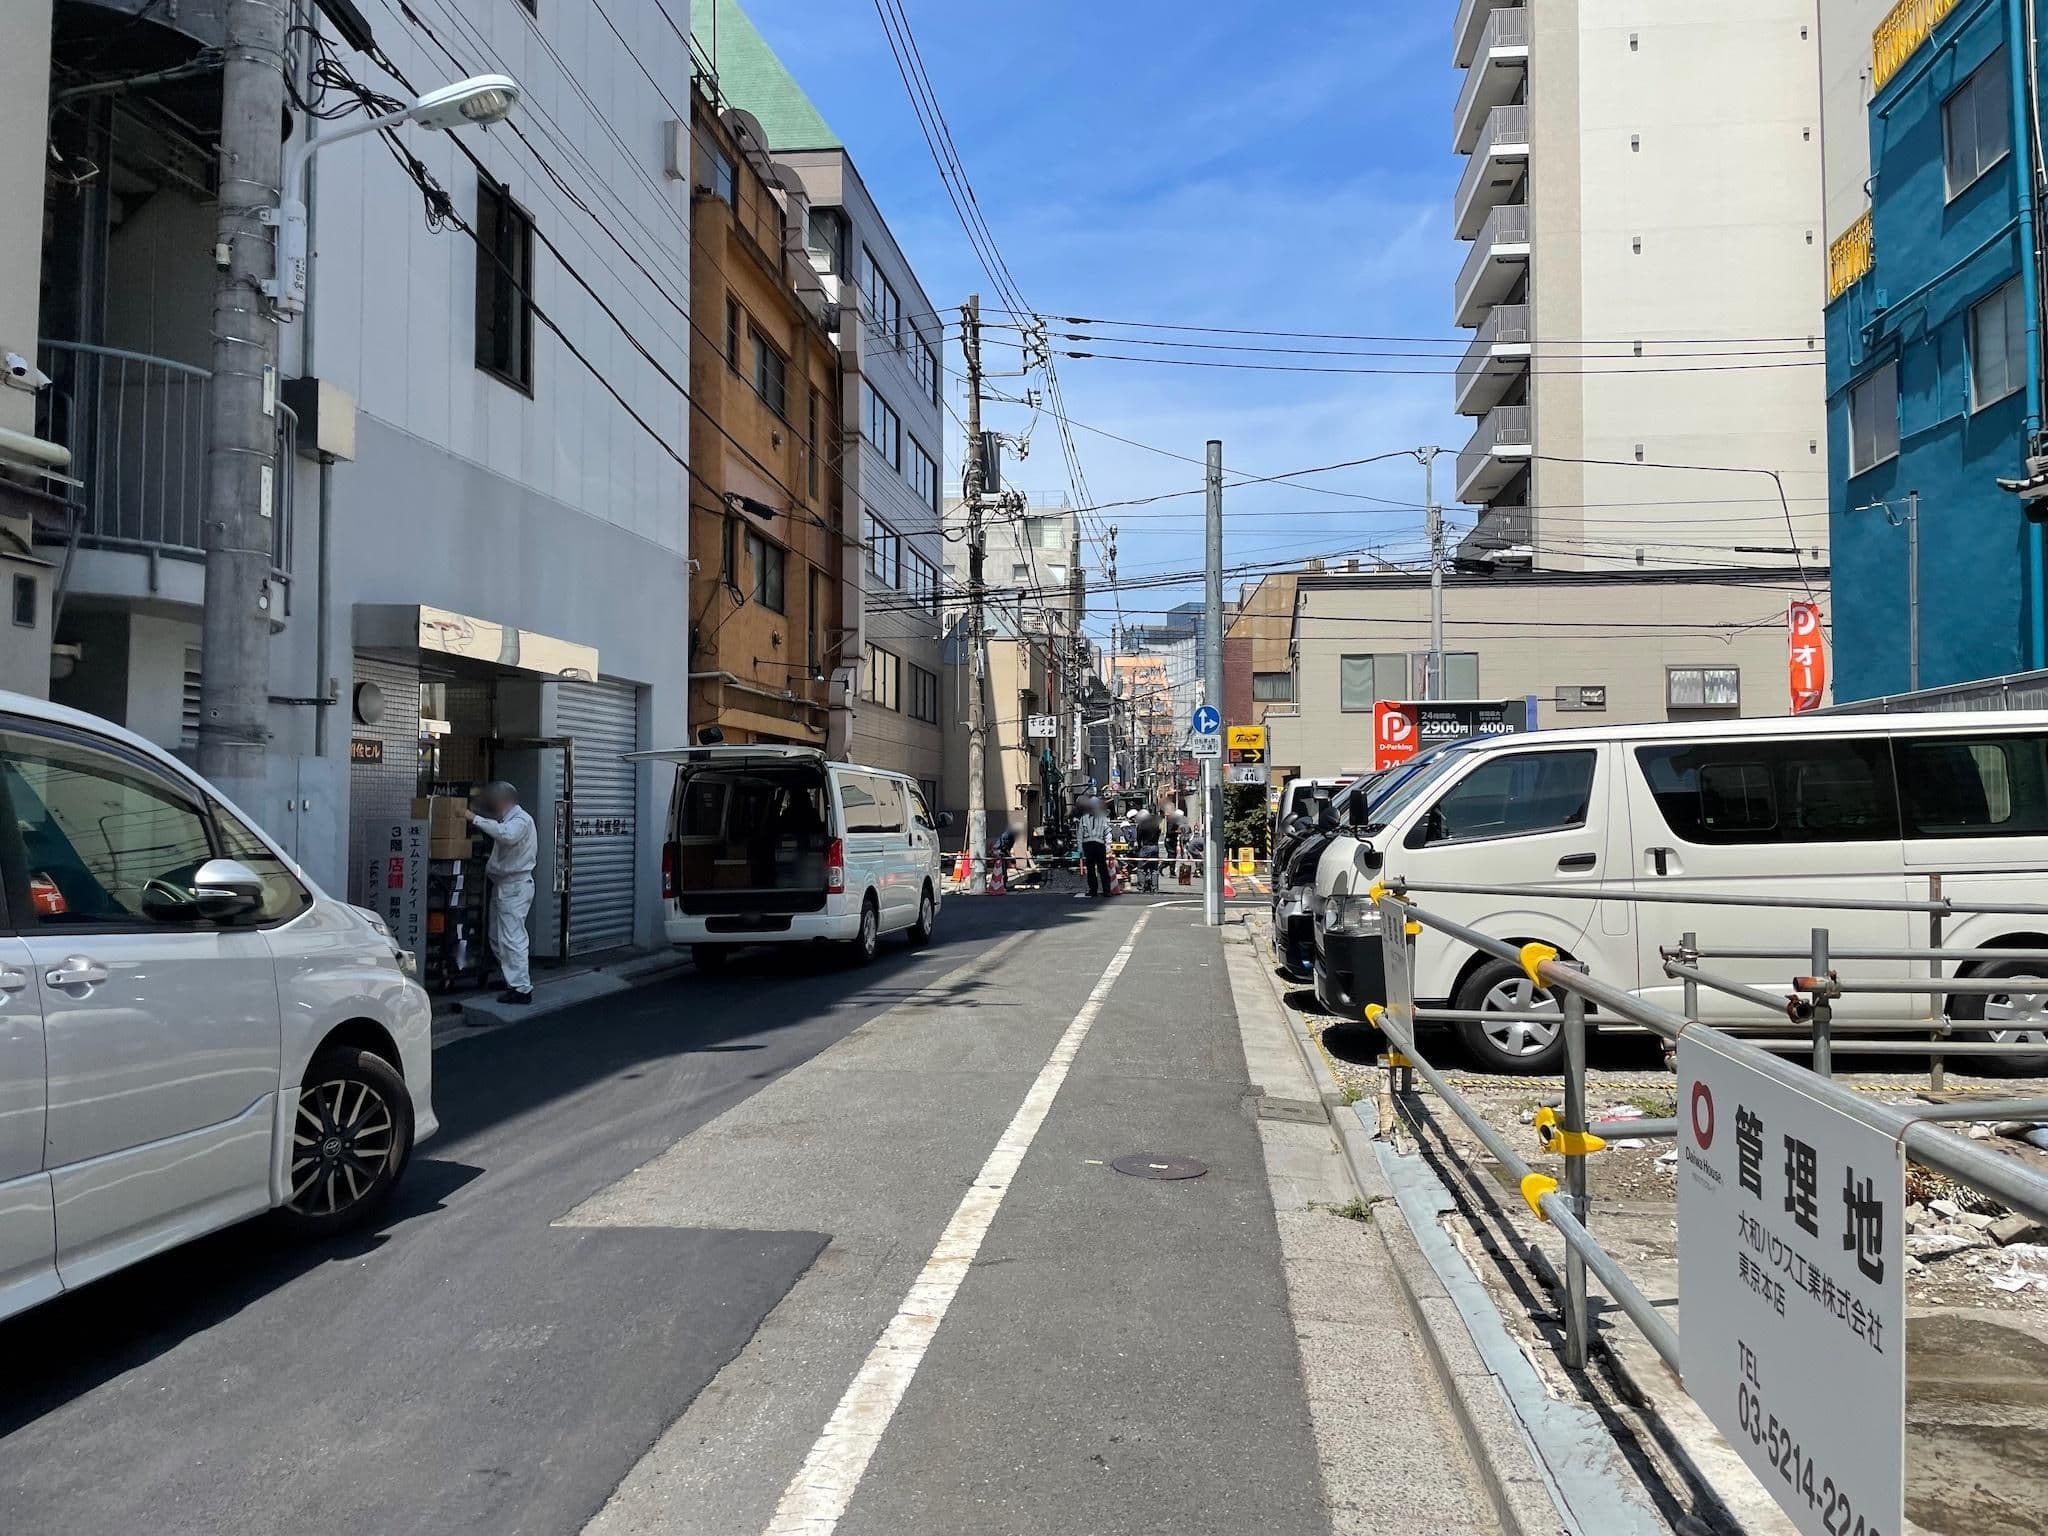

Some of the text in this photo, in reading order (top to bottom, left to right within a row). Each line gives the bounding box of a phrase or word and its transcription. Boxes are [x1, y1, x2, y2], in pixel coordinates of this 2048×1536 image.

[1421, 721, 1469, 736] 2900円
[1478, 721, 1515, 734] 400円
[1379, 743, 1413, 752] D-Parking
[387, 856, 405, 890] 店舗
[1703, 1159, 1722, 1184] House
[1735, 1104, 1885, 1285] 管理地
[1737, 1209, 1884, 1354] 大和ハウス工業株式会社
[1738, 1250, 1786, 1319] 東京本店
[1737, 1339, 1761, 1390] TEL
